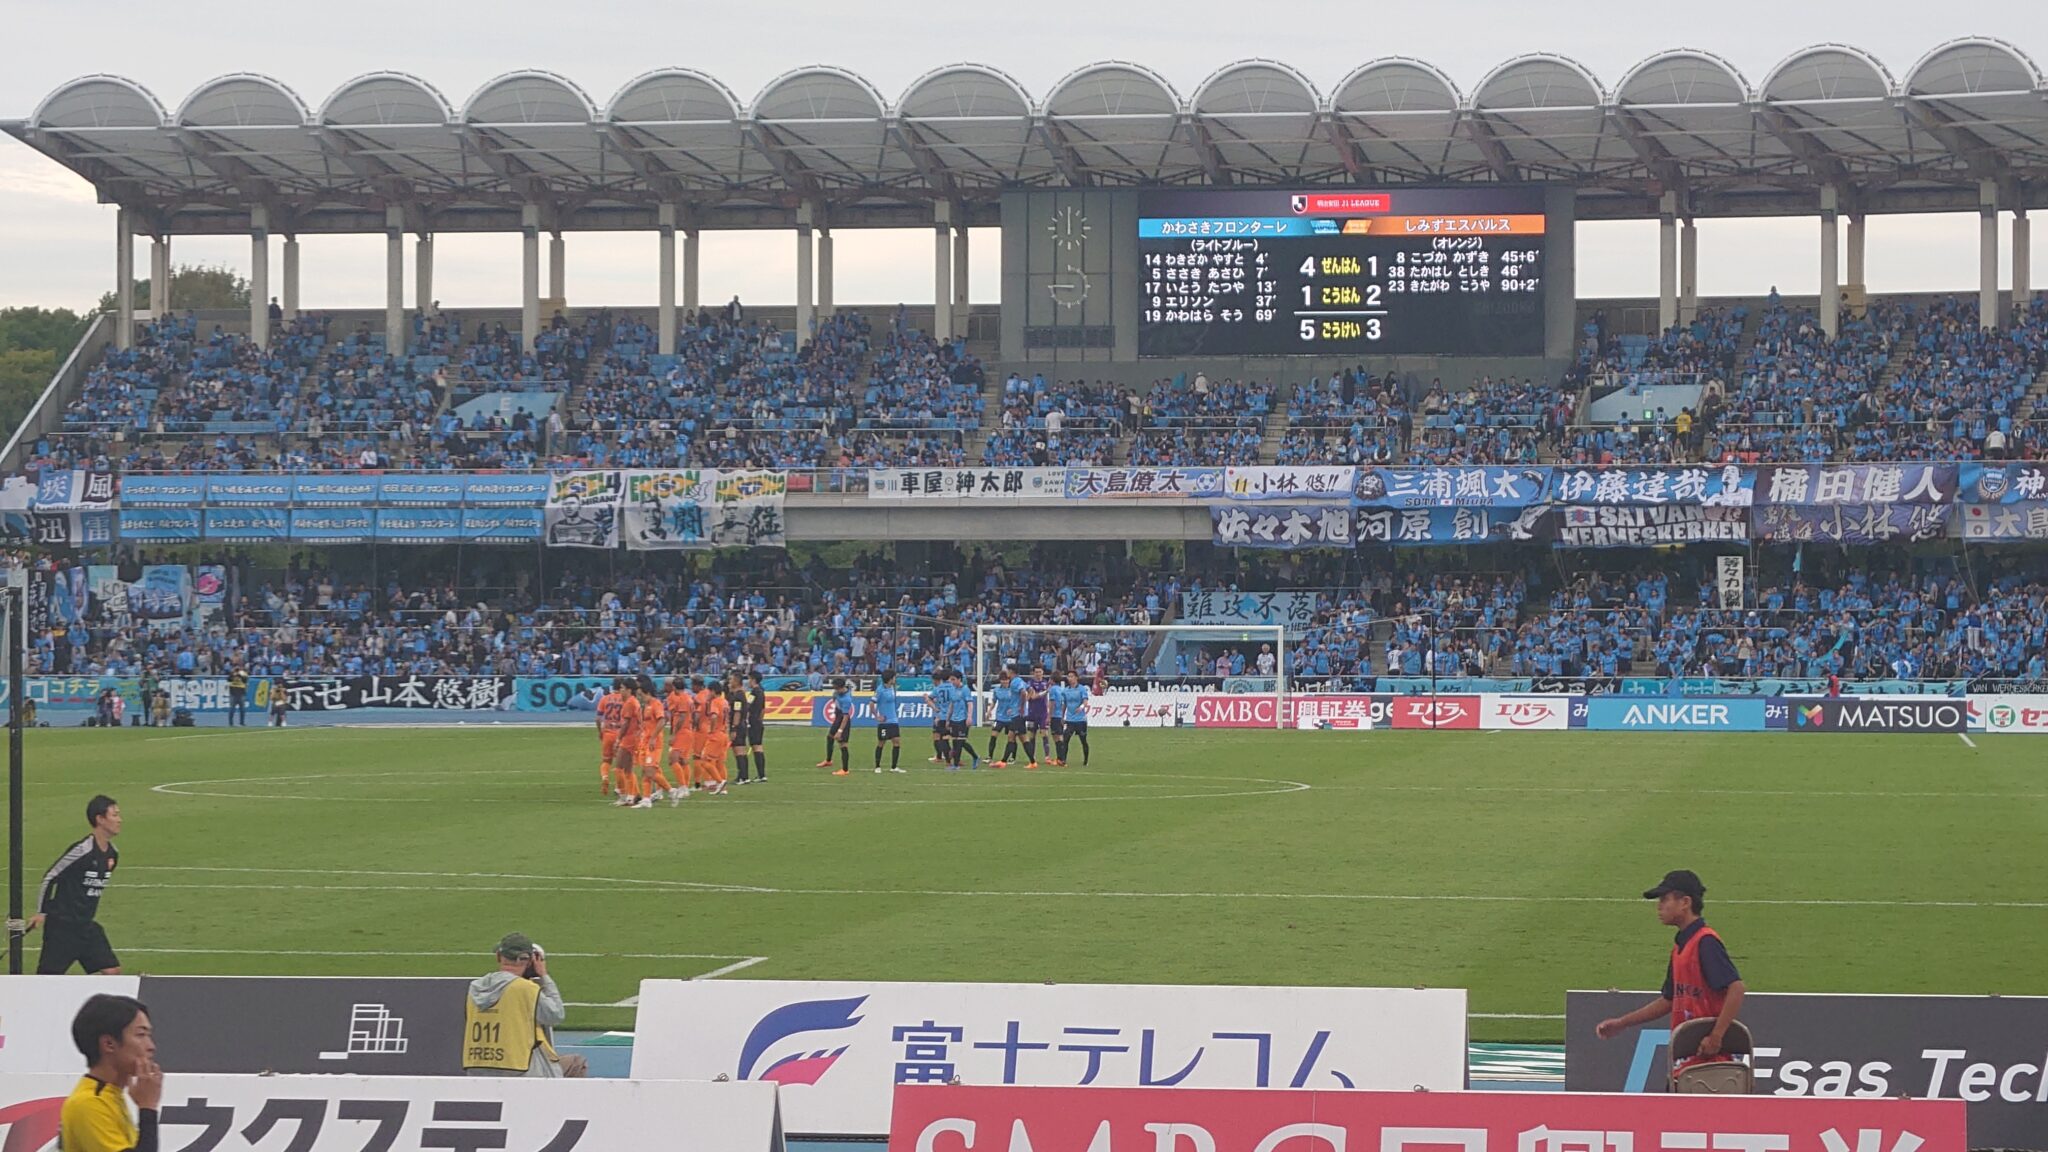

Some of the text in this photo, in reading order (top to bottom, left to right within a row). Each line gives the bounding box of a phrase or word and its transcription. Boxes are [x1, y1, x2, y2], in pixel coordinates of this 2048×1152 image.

[1162, 220, 1288, 235] かわさきフロンターレ
[1432, 237, 1483, 250] (オレンジ)
[1145, 254, 1161, 265] 14
[1165, 253, 1208, 265] わきざか
[1212, 253, 1244, 265] やすと
[1300, 255, 1378, 277] 4 ぜんはん 1
[1396, 252, 1405, 263] 8
[1410, 251, 1448, 264] こづか
[1452, 251, 1490, 263] かずき
[1152, 268, 1161, 279] 5
[1165, 267, 1201, 279] ささき
[1208, 267, 1245, 279] あさひ
[1388, 266, 1406, 278] 38
[1409, 265, 1452, 278] たかはし
[1458, 265, 1490, 277] としき
[1145, 282, 1161, 293] 17
[1165, 281, 1201, 293] いとう
[1208, 281, 1245, 293] たつや
[1301, 284, 1382, 306] 1 こうはん 2
[1388, 279, 1405, 291] 23
[1409, 279, 1450, 292] きたがわ
[1460, 279, 1490, 292] こうや
[1152, 296, 1161, 307] 9
[1165, 296, 1214, 307] エリソン
[1145, 310, 1161, 321] 19
[1165, 309, 1214, 321] かわはら
[1220, 310, 1243, 321] そう
[1300, 318, 1316, 340] 5
[1366, 318, 1382, 340] 3
[1076, 470, 1185, 494] 大島僚太
[1254, 472, 1299, 494] 小林
[1386, 469, 1521, 498] 三浦颯太
[1559, 468, 1710, 503] 伊藤達哉
[1768, 466, 1944, 502] 橘田健人
[2014, 468, 2046, 496] 神
[1358, 509, 1490, 542] 河原 創
[1599, 504, 1705, 527] SAI VAN
[1820, 505, 1900, 541] 小林
[1993, 507, 2048, 539] 大島
[1217, 509, 1351, 545] 佐々木旭
[1186, 591, 1313, 621] 難攻不落
[51, 679, 100, 695] コチラ
[360, 675, 505, 710] 山本悠樹
[1198, 700, 1273, 722] SMBC
[1408, 703, 1468, 722] エバラ
[1496, 703, 1555, 722] エバラ
[1621, 704, 1730, 726] ANKER
[1838, 705, 1960, 728] MATSUO
[472, 1021, 501, 1043] 011
[468, 1047, 505, 1062] PRESS
